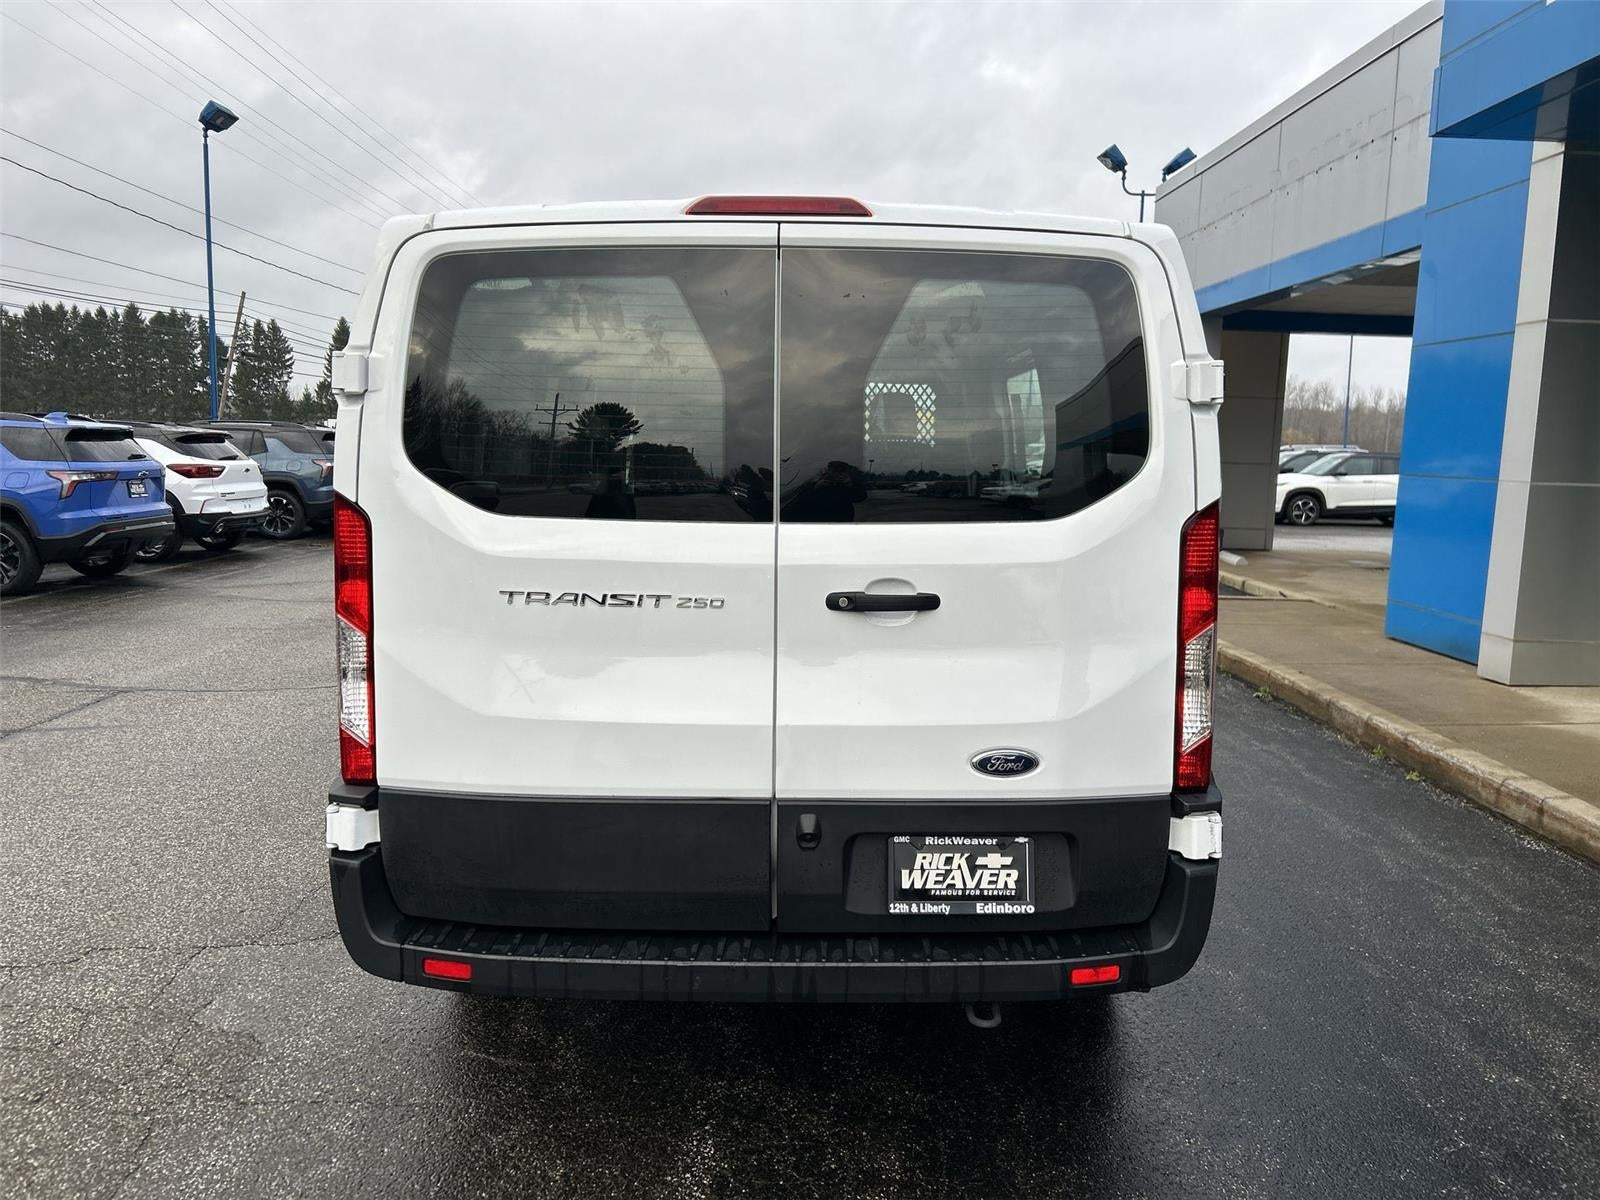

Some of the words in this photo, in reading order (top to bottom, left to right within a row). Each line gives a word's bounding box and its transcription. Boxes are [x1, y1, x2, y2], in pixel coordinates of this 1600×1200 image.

[498, 590, 672, 608] TRANSIT
[676, 597, 725, 609] 250
[986, 755, 1025, 771] Ford
[925, 836, 998, 845] RickWeaver
[914, 852, 971, 870] RICK
[901, 869, 1019, 889] WEAVER
[889, 903, 909, 913] 12th
[911, 903, 919, 913] &
[920, 903, 951, 915] Liberty
[976, 902, 1035, 914] Edinboro
